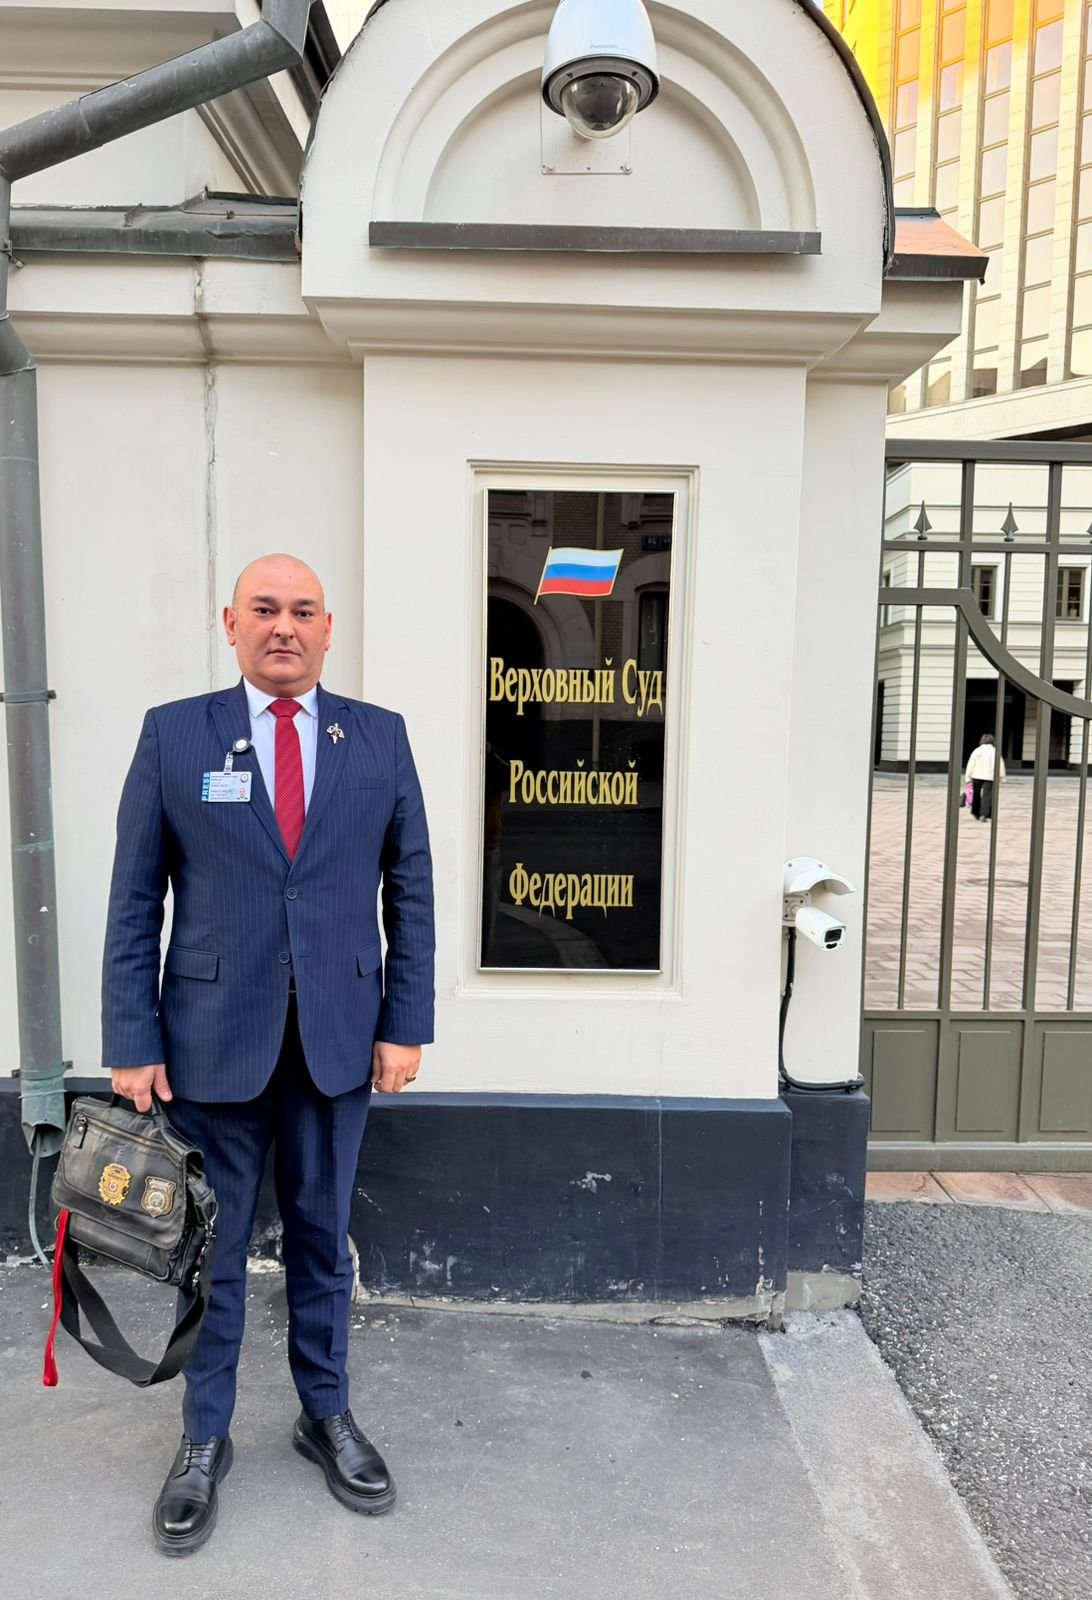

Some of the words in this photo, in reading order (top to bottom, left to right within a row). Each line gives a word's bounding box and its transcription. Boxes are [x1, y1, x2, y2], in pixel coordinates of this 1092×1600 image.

[489, 657, 616, 716] Верховный
[621, 658, 663, 718] Суд
[201, 772, 210, 801] PRESS
[509, 758, 639, 806] Российской
[508, 862, 635, 920] Федерации
